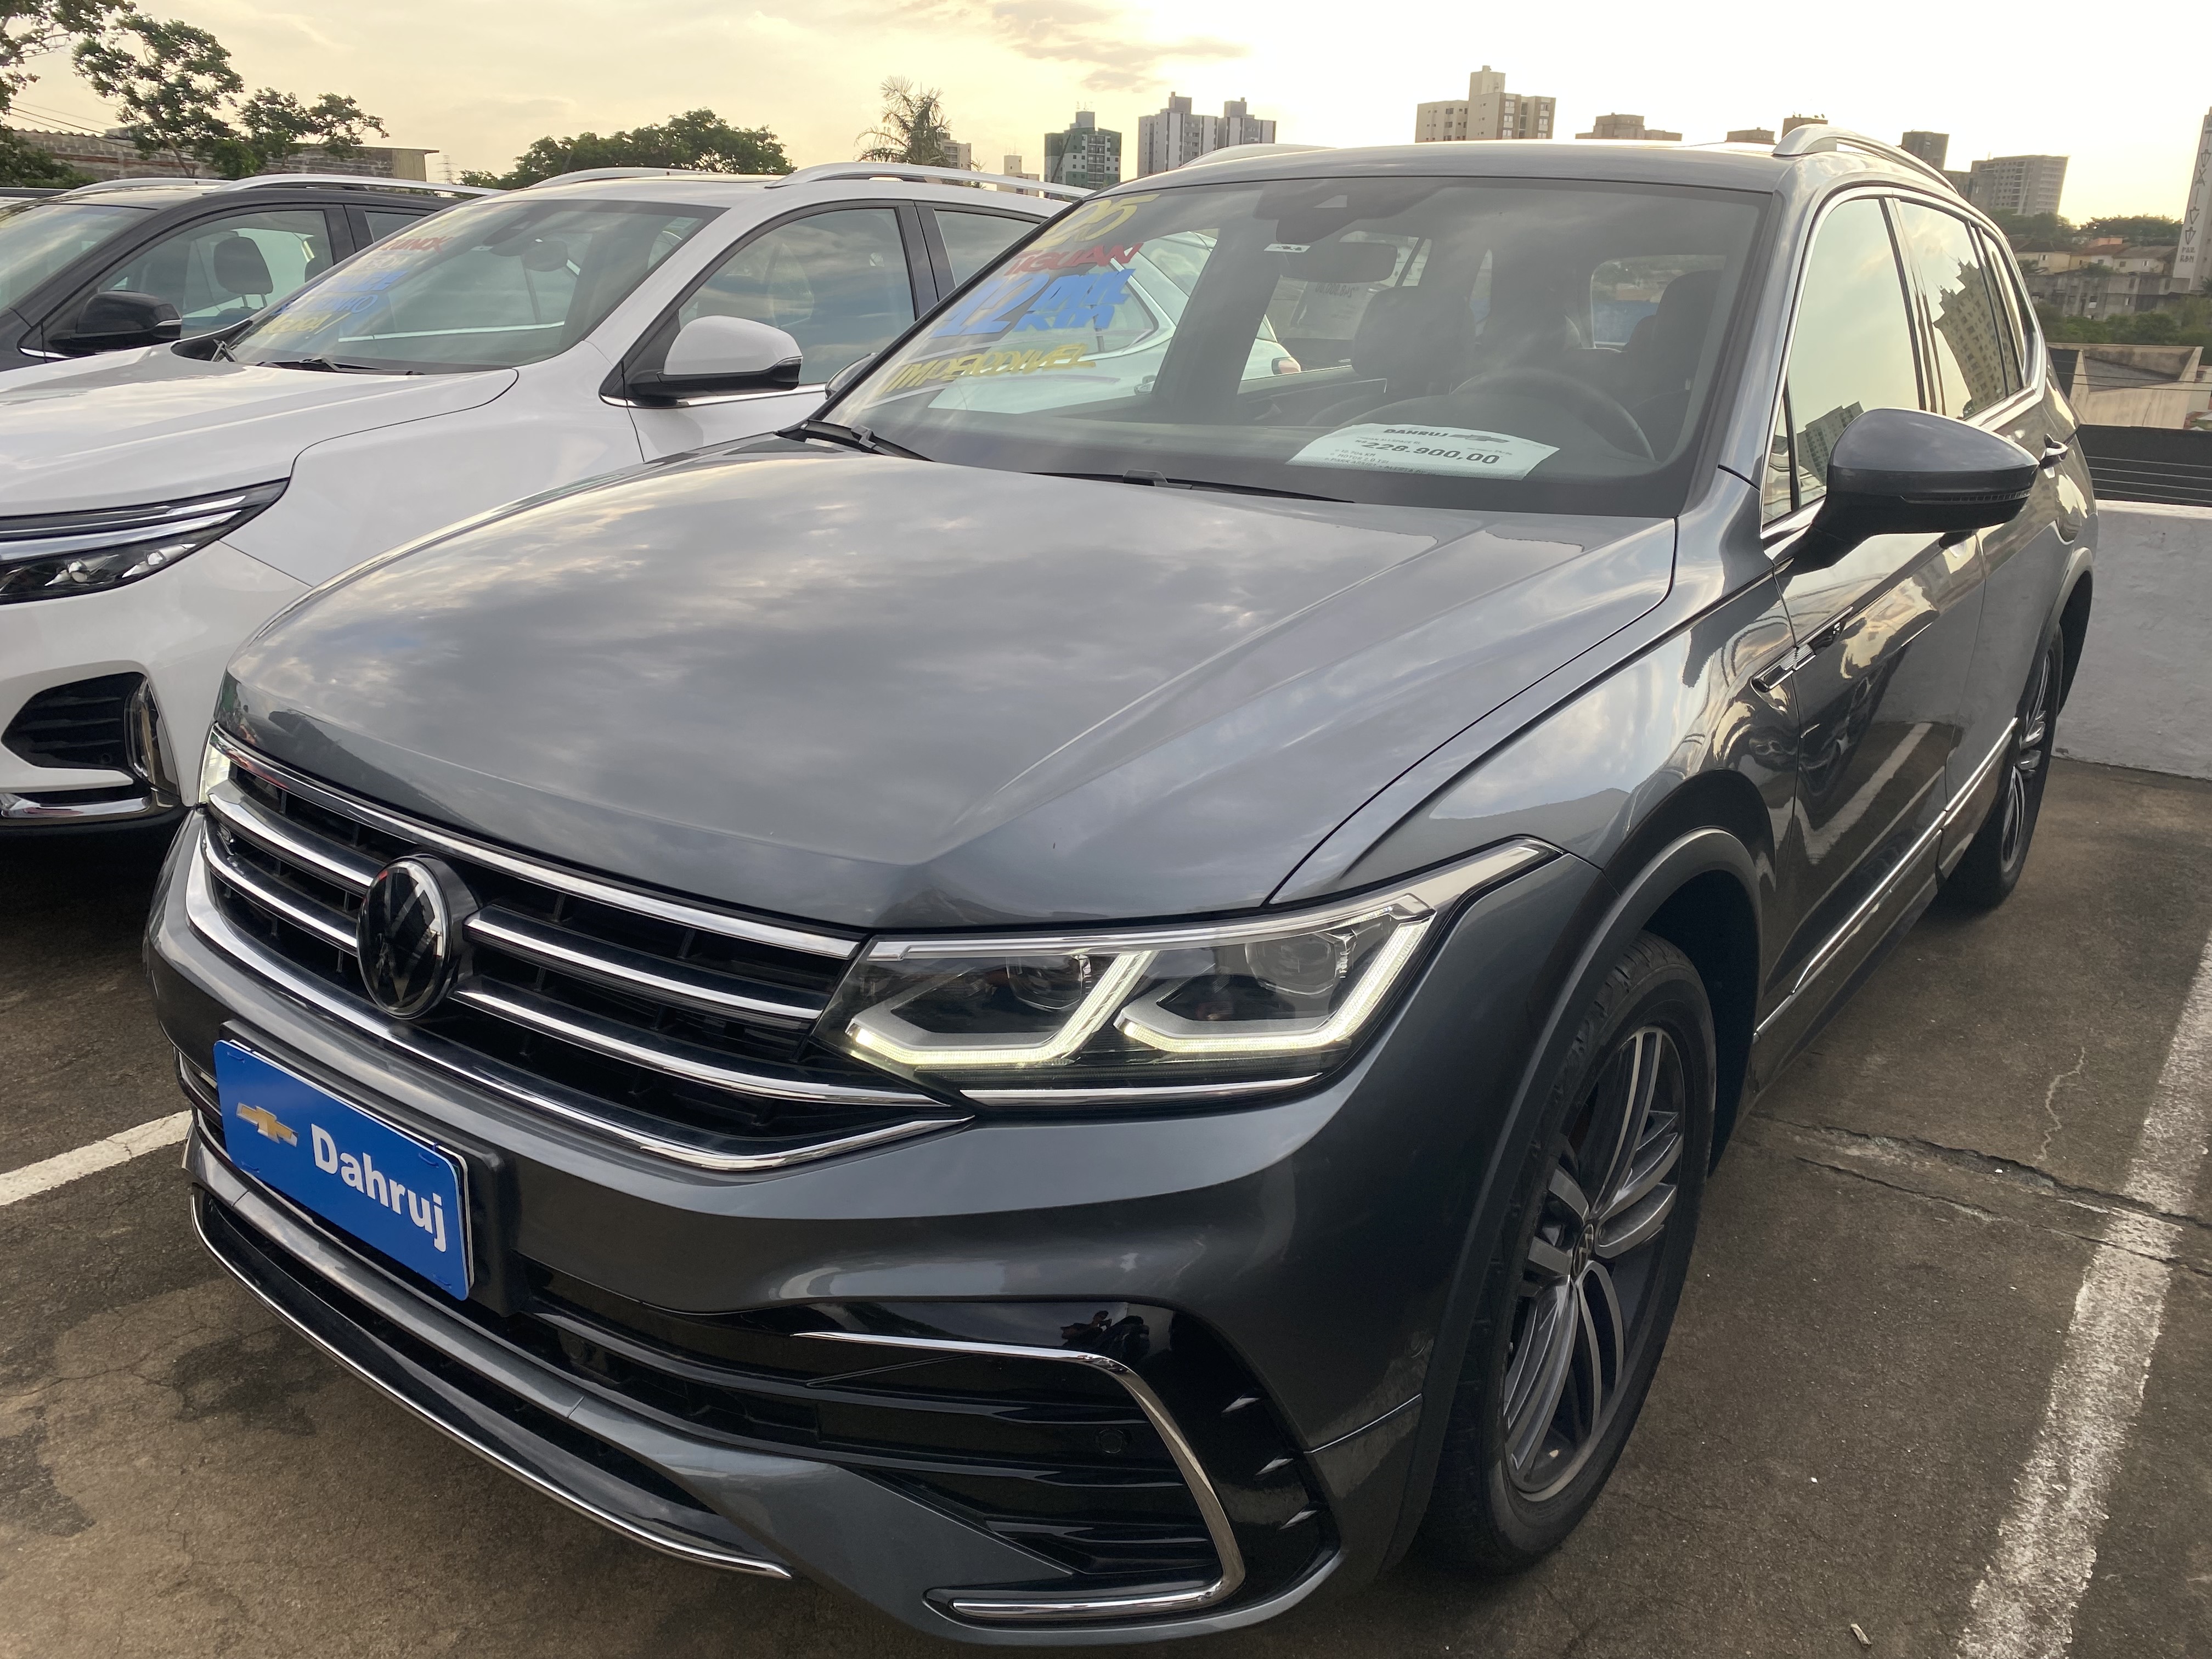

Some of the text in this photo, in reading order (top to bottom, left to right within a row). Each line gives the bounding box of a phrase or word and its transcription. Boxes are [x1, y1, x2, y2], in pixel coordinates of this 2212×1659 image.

[1003, 242, 1144, 275] TIGUAN
[1383, 428, 1449, 437] DAHRUJ
[1361, 442, 1500, 464] 228.900,00
[311, 1123, 447, 1252] Dahruj
